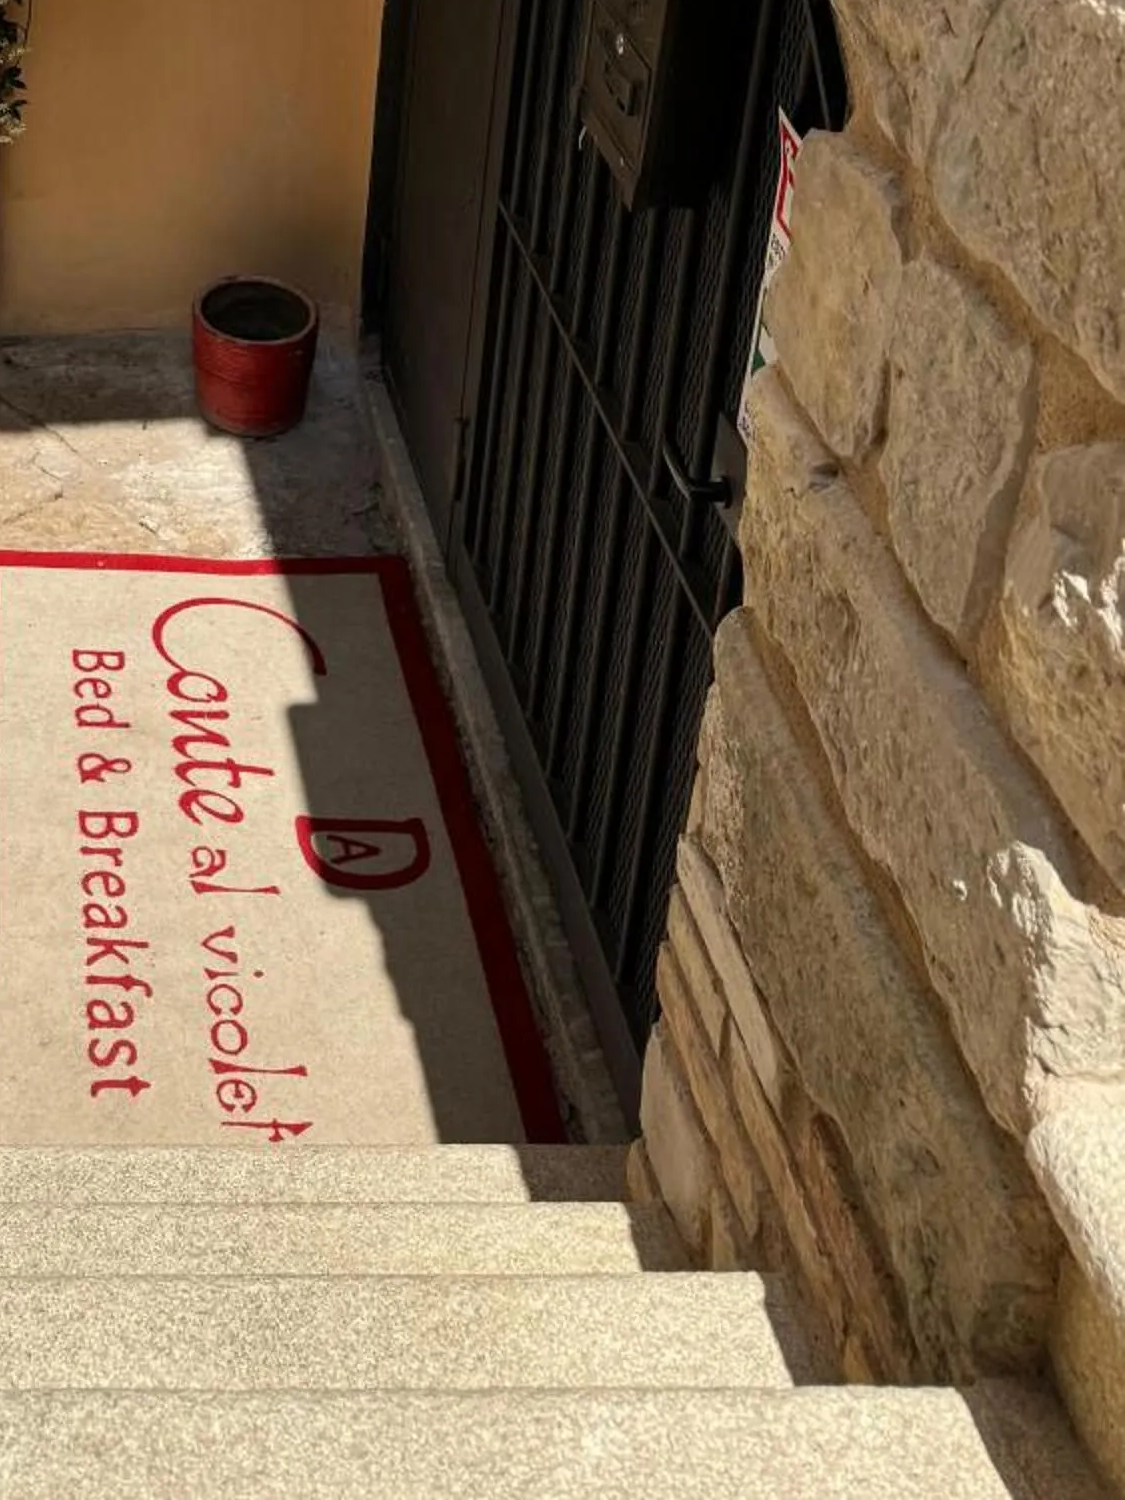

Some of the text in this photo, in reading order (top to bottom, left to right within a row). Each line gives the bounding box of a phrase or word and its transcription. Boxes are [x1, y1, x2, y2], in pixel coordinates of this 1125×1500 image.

[151, 596, 327, 825] Conte
[72, 648, 154, 1099] Bed & Breakfast
[188, 845, 281, 896] al
